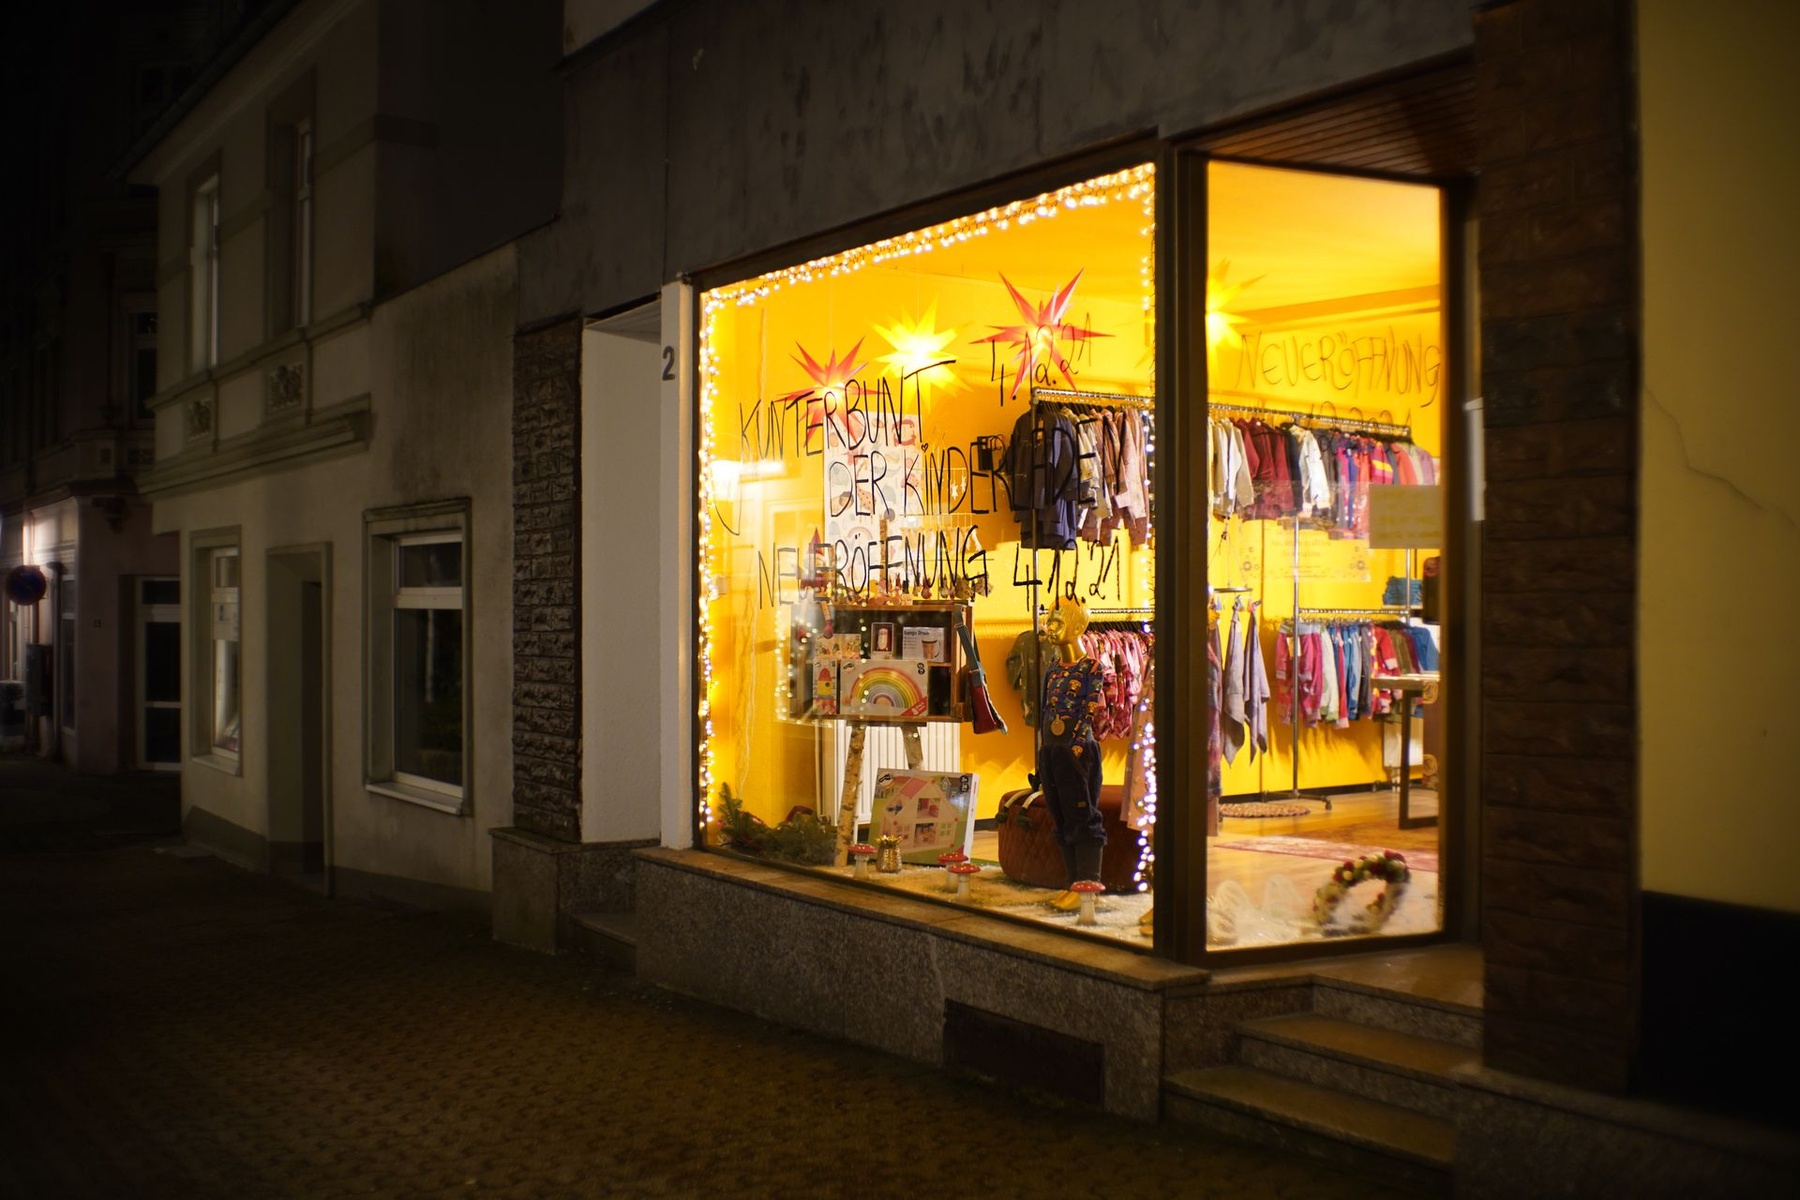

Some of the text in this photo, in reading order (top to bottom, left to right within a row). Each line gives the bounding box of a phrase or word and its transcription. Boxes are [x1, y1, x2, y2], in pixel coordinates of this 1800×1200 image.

[662, 345, 676, 381] 2
[738, 359, 957, 460] KUNTERBUNT
[828, 449, 891, 518] DER
[757, 524, 989, 610] NEUERÖFFNUNG
